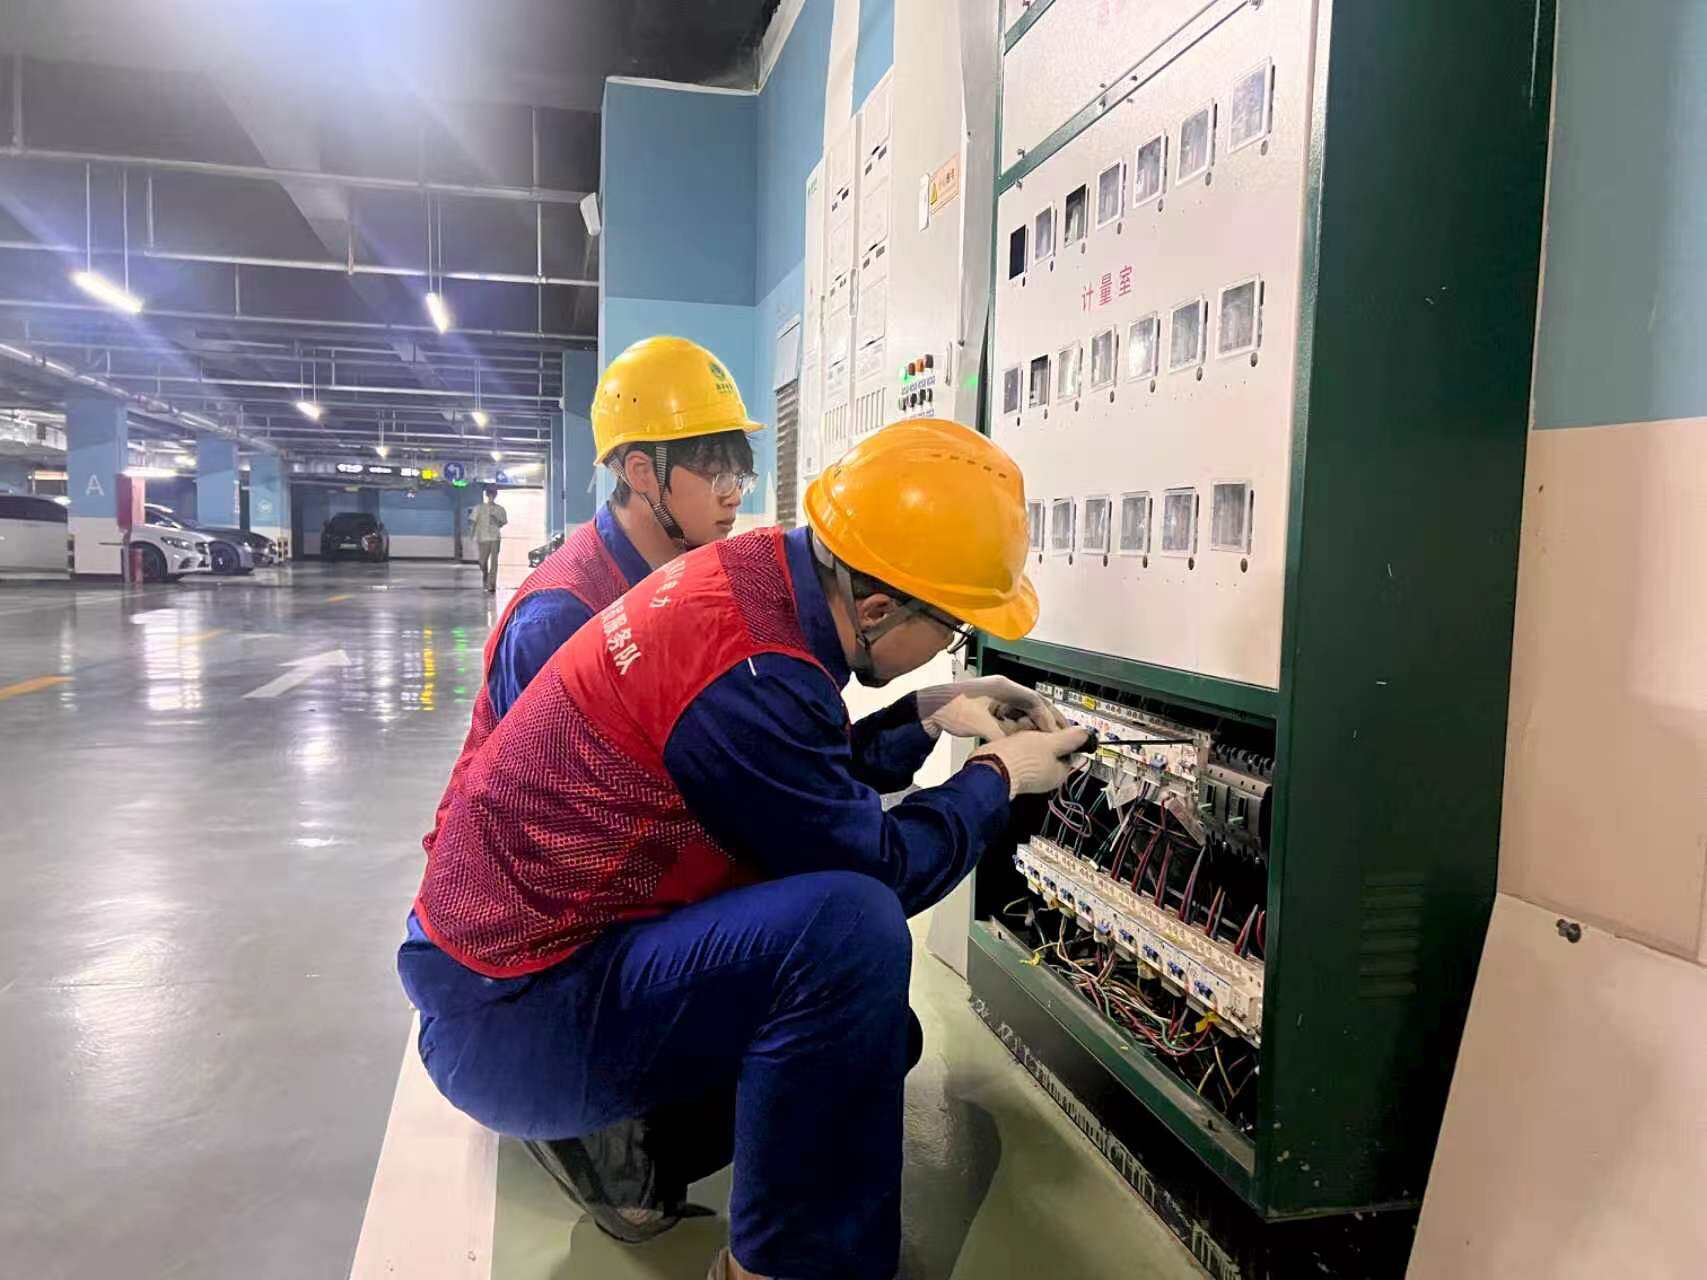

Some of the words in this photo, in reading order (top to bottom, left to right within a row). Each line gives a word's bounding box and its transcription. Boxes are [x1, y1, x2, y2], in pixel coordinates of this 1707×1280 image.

[1081, 264, 1132, 311] 计量室
[86, 474, 105, 496] A
